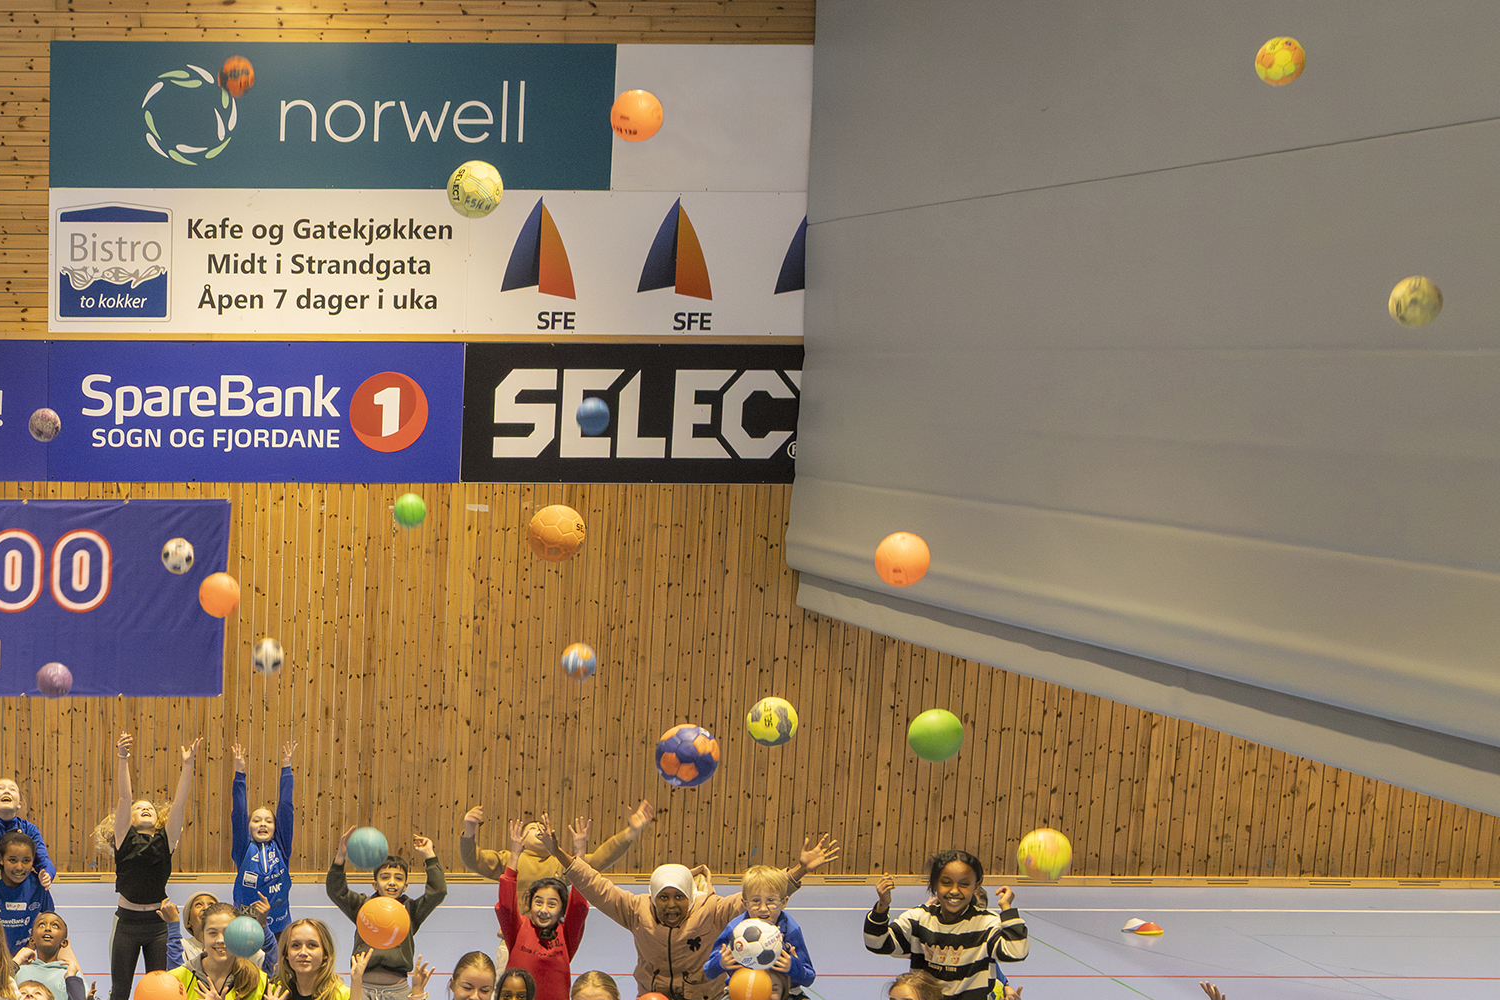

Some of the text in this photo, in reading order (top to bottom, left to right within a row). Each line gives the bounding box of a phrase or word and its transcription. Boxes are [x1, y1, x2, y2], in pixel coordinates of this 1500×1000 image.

[280, 81, 525, 143] norwell
[452, 168, 465, 201] SELECT
[187, 218, 453, 246] Kafe og Gatekjøkken
[70, 232, 163, 263] Bistro
[207, 253, 431, 281] Midt i Strandgata
[80, 293, 148, 309] to kokker
[198, 283, 438, 316] Åpen 7 dager i uka
[537, 312, 576, 330] SFE
[673, 312, 713, 330] SFE
[81, 374, 401, 438] SpareBank 1
[493, 369, 802, 459] SELEC
[91, 429, 341, 453] SOGN OG FJORDANE
